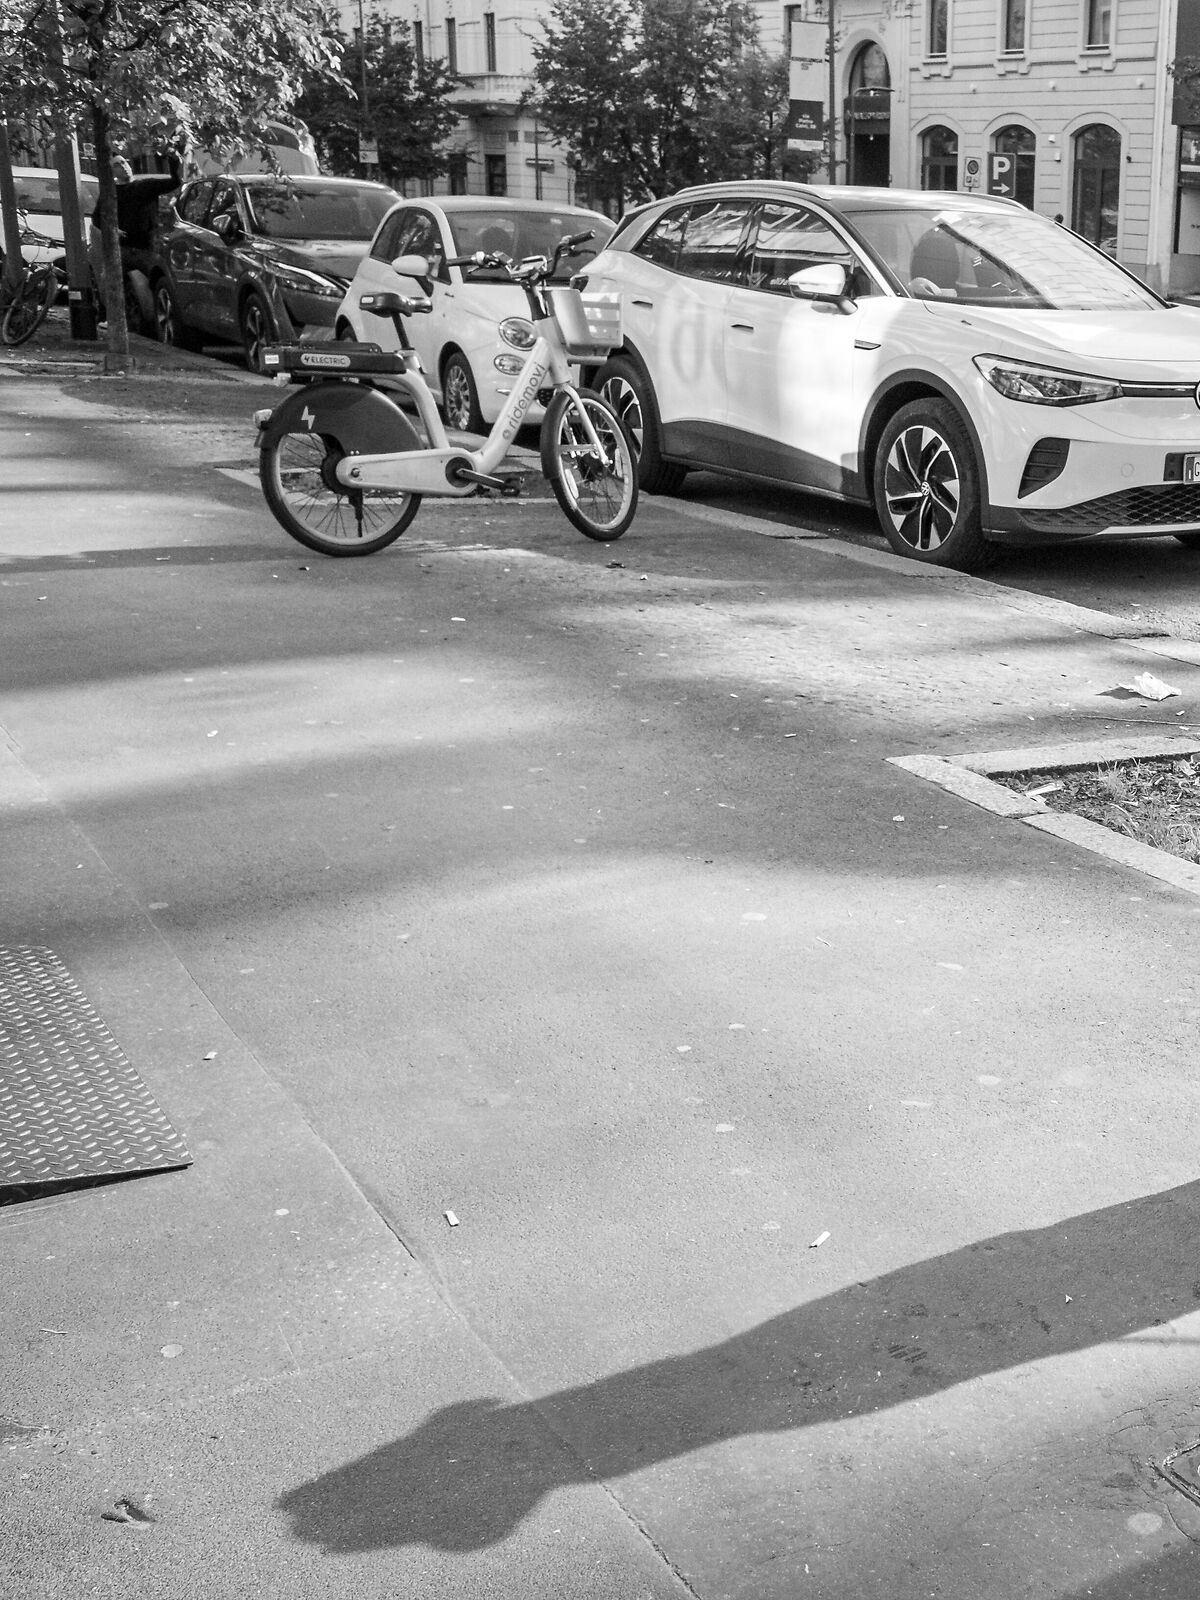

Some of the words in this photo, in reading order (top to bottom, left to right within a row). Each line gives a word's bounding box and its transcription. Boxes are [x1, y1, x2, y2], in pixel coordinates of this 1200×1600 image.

[993, 156, 1011, 180] P
[311, 356, 346, 365] ELECTRIC
[509, 361, 546, 429] ridemovi
